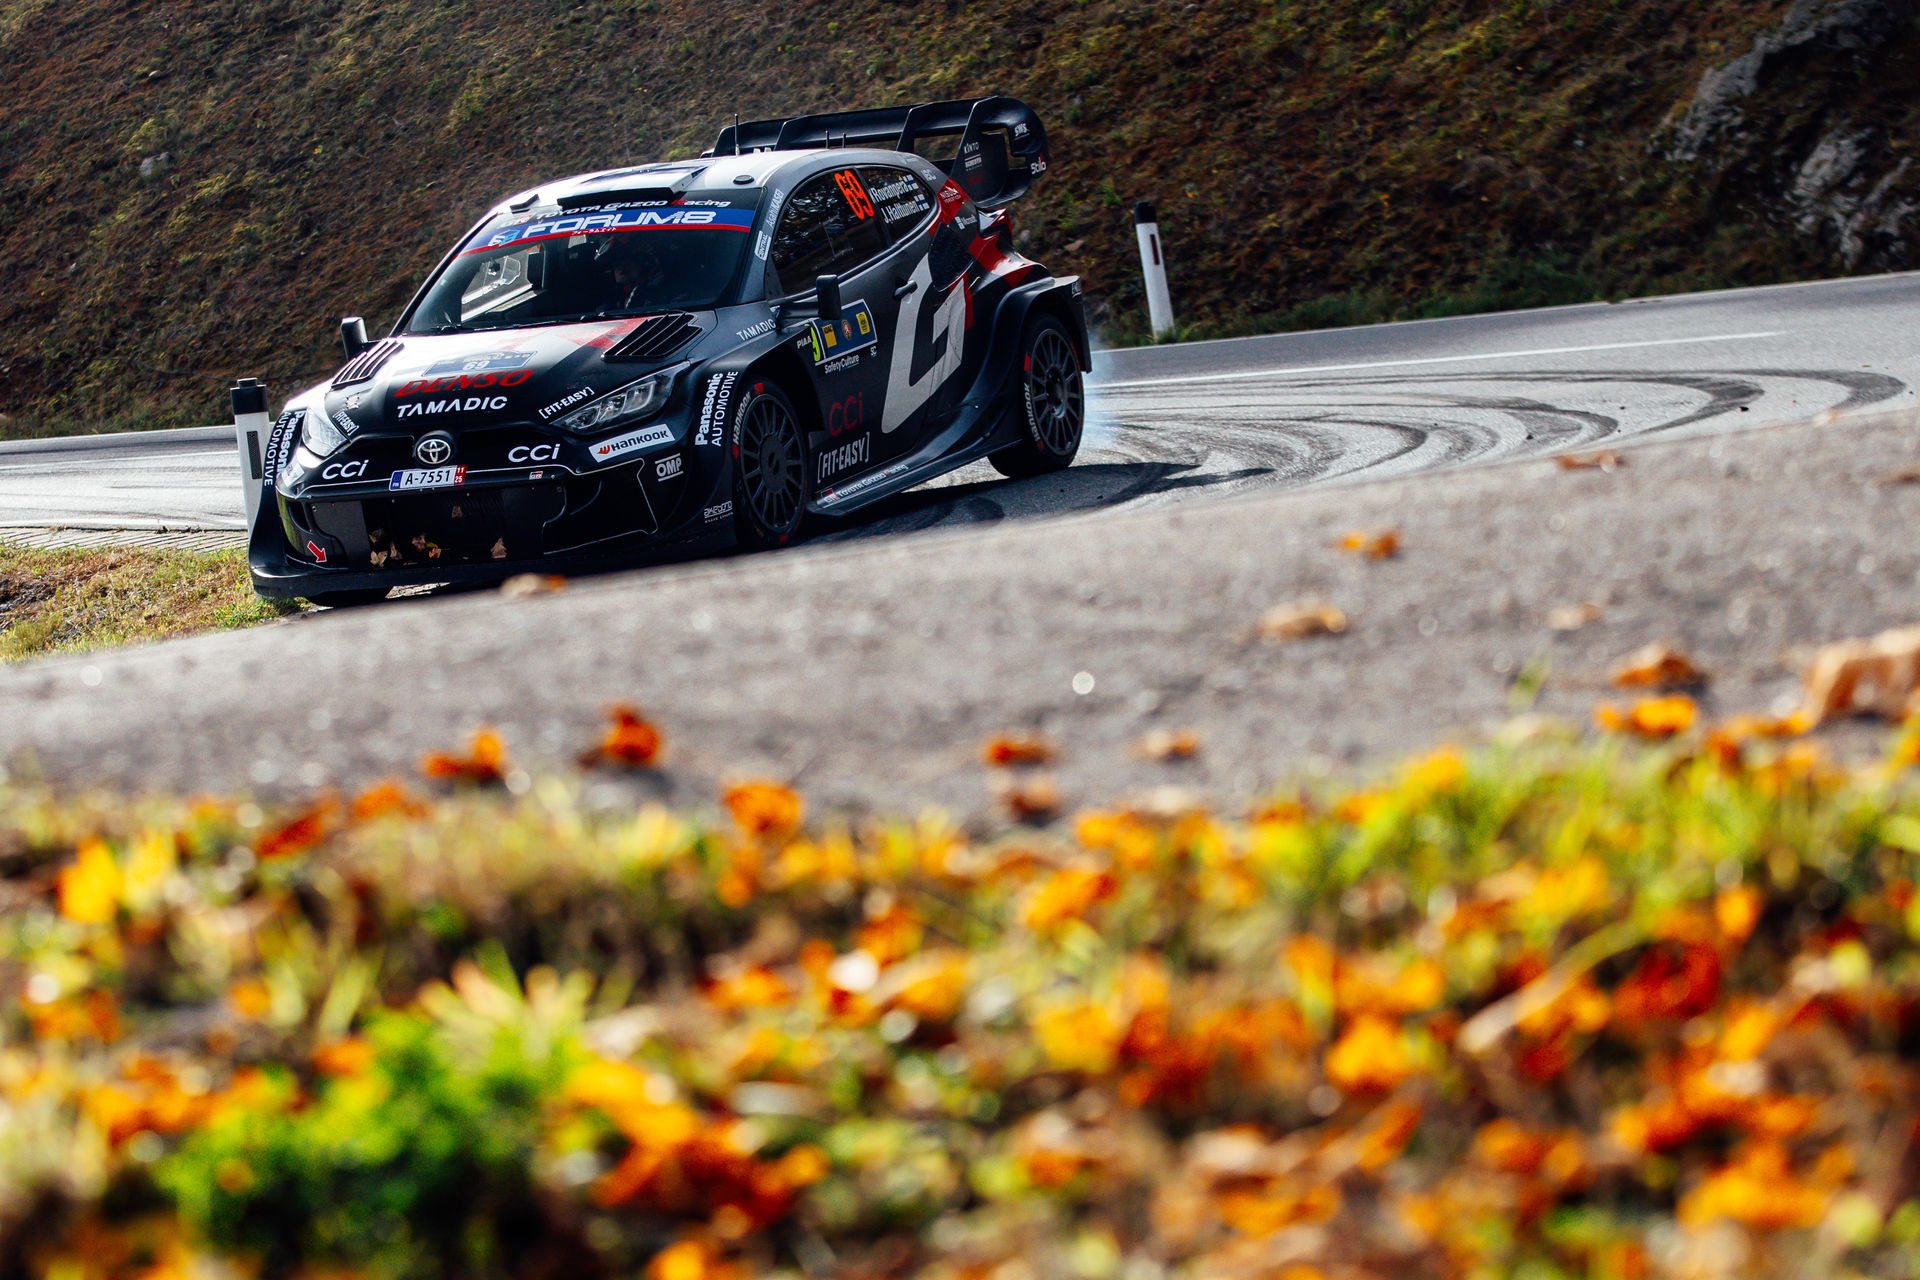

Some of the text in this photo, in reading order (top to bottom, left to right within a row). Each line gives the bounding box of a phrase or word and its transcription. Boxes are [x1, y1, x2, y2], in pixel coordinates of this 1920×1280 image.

[834, 170, 874, 220] 69
[536, 204, 602, 220] TOYOTA
[604, 200, 669, 211] GAZOO
[671, 199, 731, 208] Racing
[521, 211, 717, 239] FORUM8
[736, 318, 777, 341] TAMADIC
[796, 335, 812, 350] PIAA
[461, 360, 491, 371] 69
[824, 353, 861, 375] SafetyCulture
[393, 369, 534, 398] DENSO
[397, 396, 508, 418] TAMADIC
[694, 372, 724, 446] Panasonic
[711, 371, 740, 447] AUTOMOTIVE
[404, 470, 451, 486] A-7551
[656, 458, 683, 477] OMP
[454, 475, 464, 485] 25
